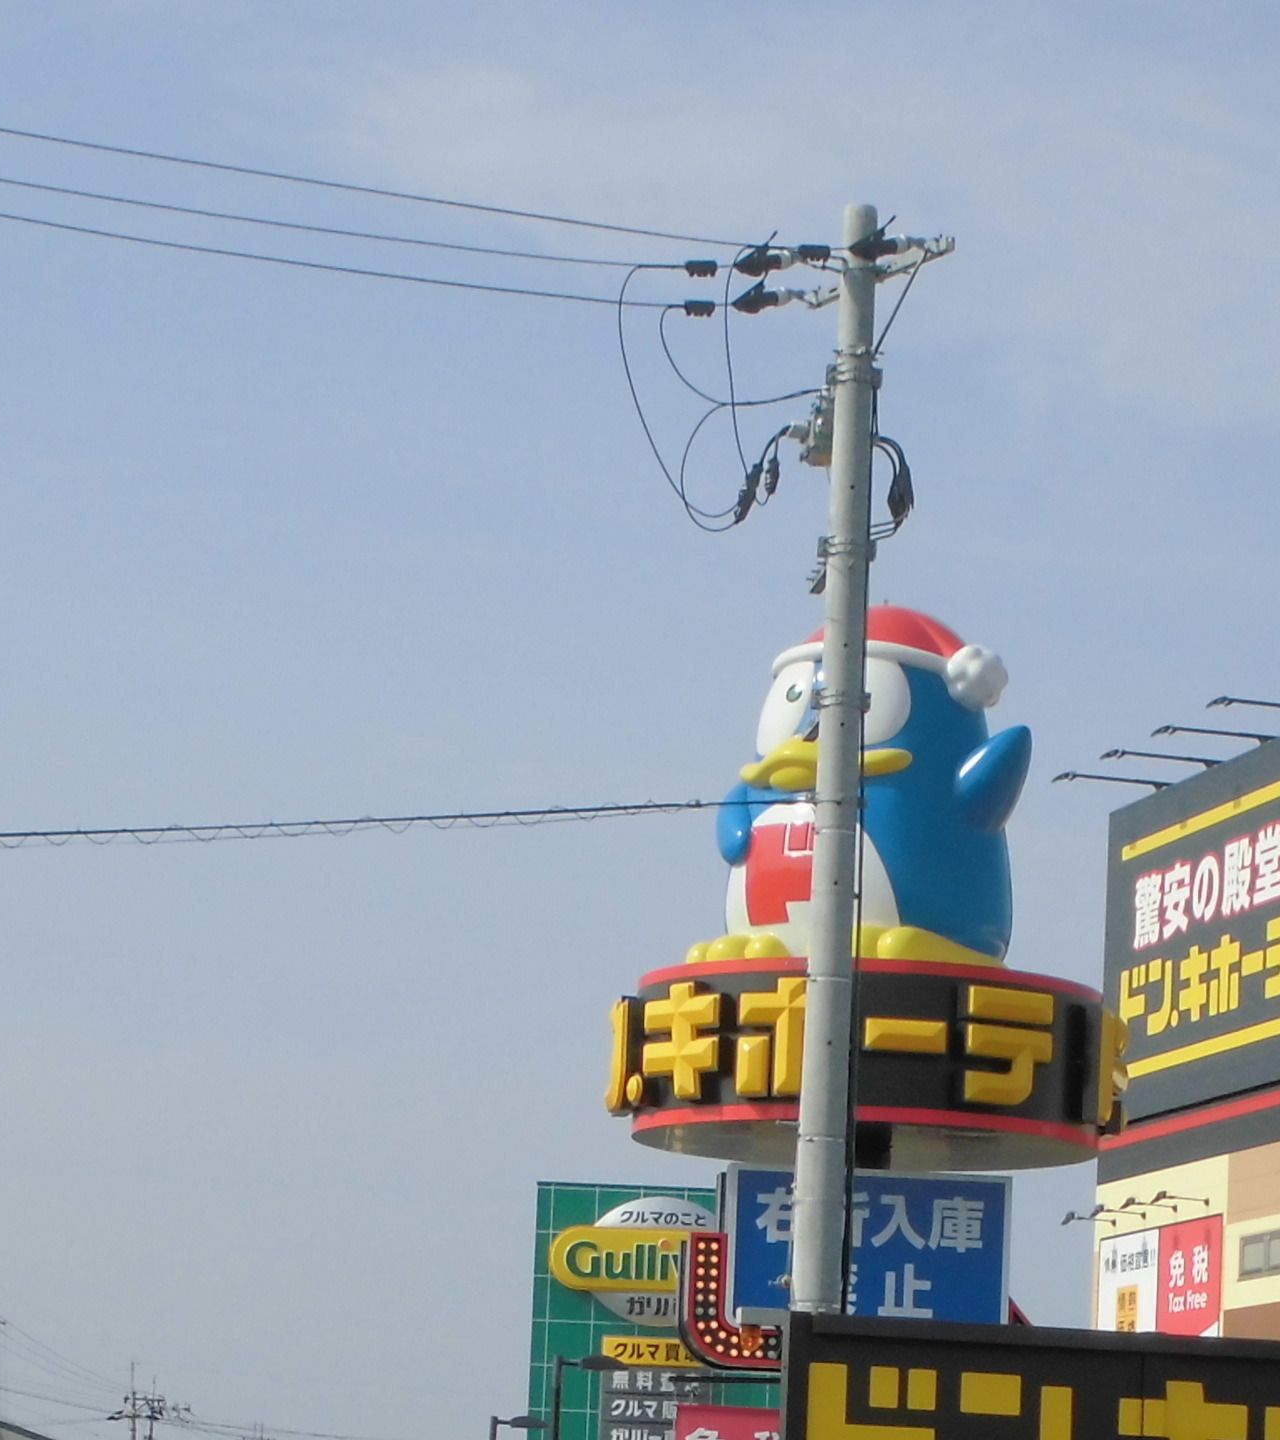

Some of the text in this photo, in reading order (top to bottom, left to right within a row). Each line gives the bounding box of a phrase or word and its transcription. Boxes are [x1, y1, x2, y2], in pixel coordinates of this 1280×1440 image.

[620, 1210, 707, 1227] クルマのこと
[1169, 1244, 1209, 1289] 免税
[1168, 1290, 1208, 1313] Tax Free
